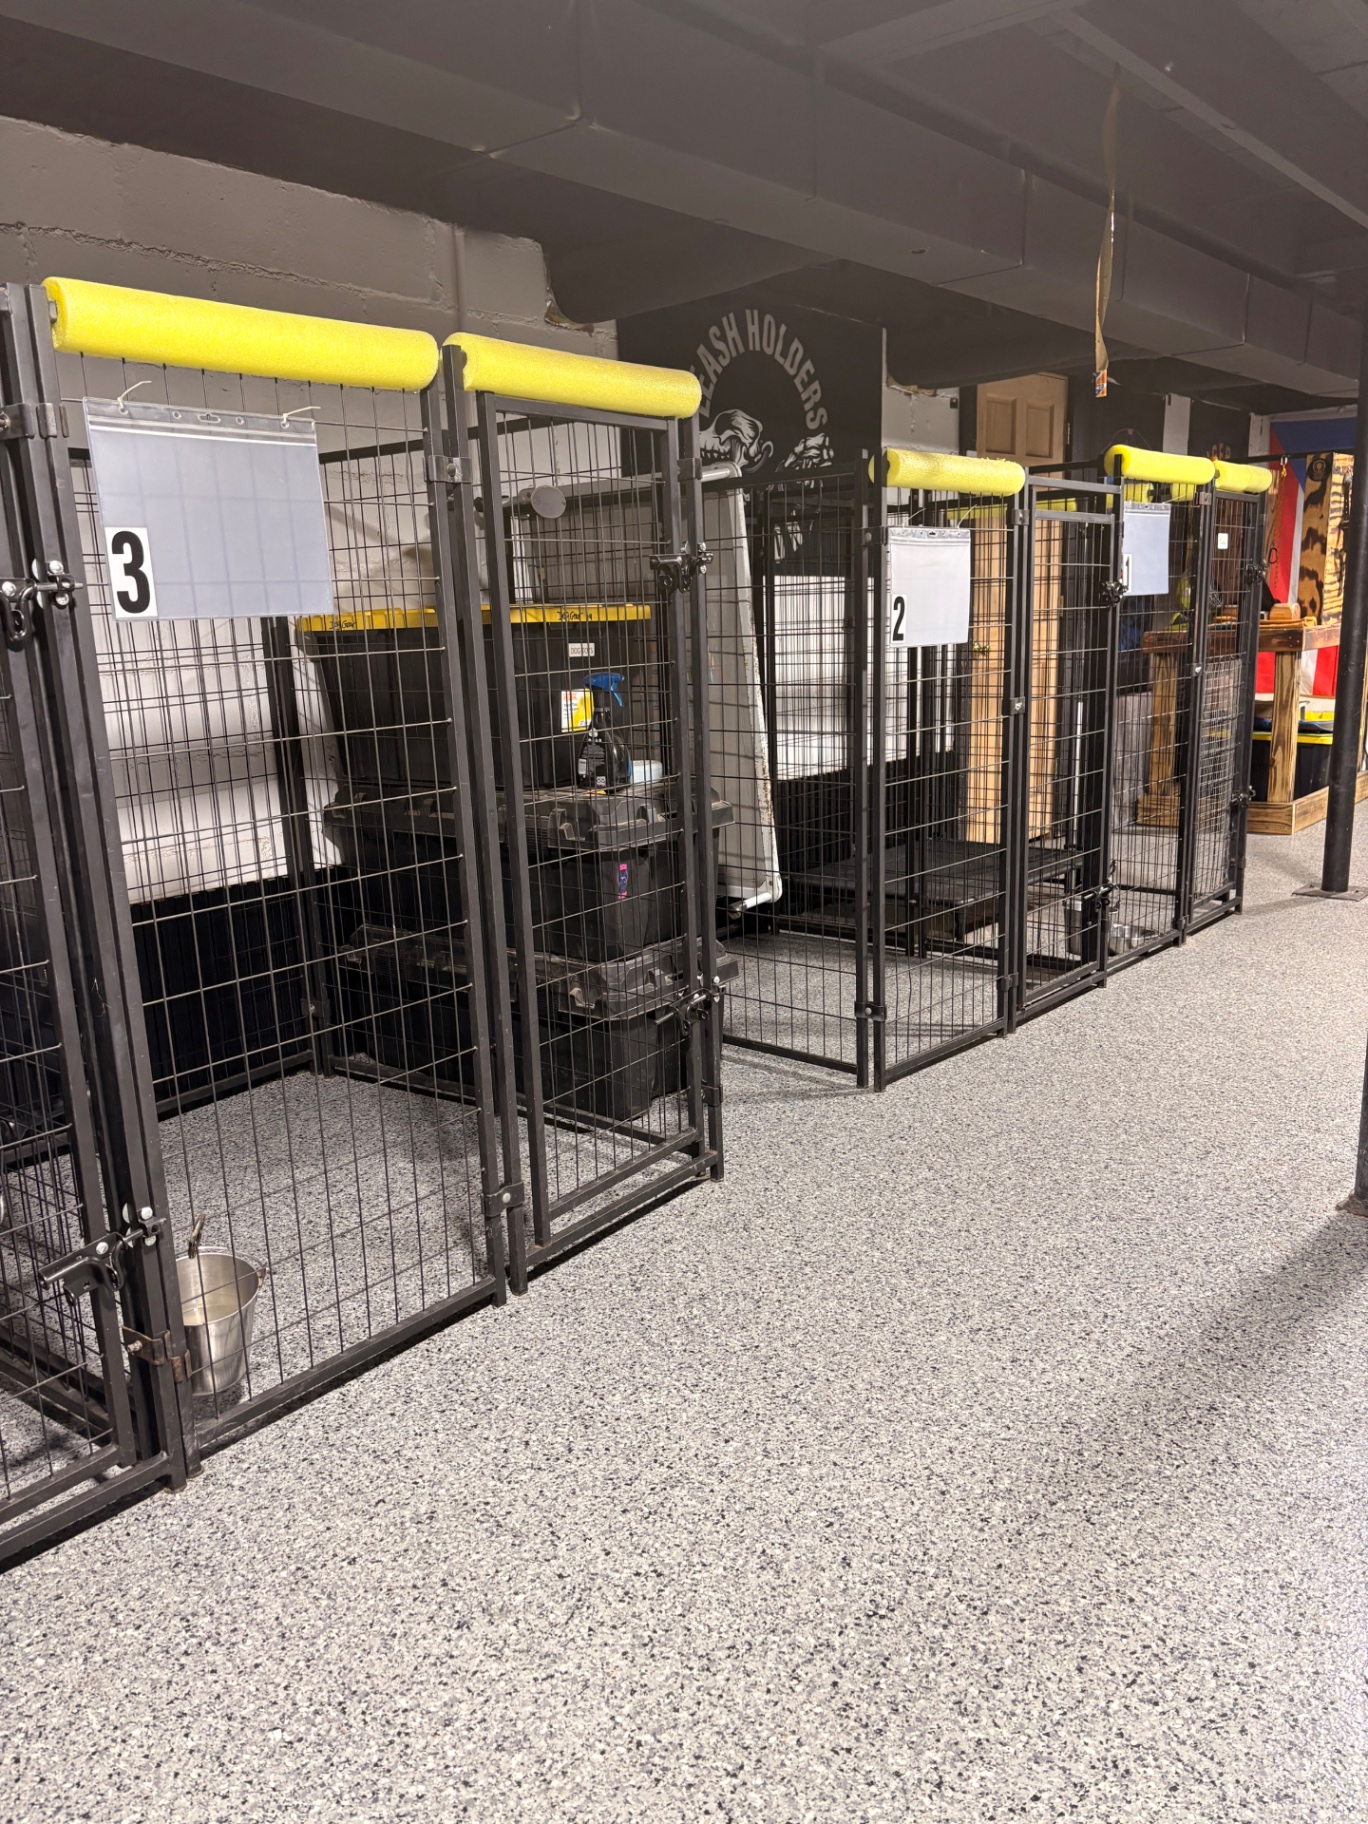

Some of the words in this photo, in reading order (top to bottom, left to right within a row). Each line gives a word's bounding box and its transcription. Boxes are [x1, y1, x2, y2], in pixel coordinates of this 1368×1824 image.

[745, 309, 828, 430] HOLDERS
[111, 530, 151, 614] 3
[892, 596, 906, 641] 2
